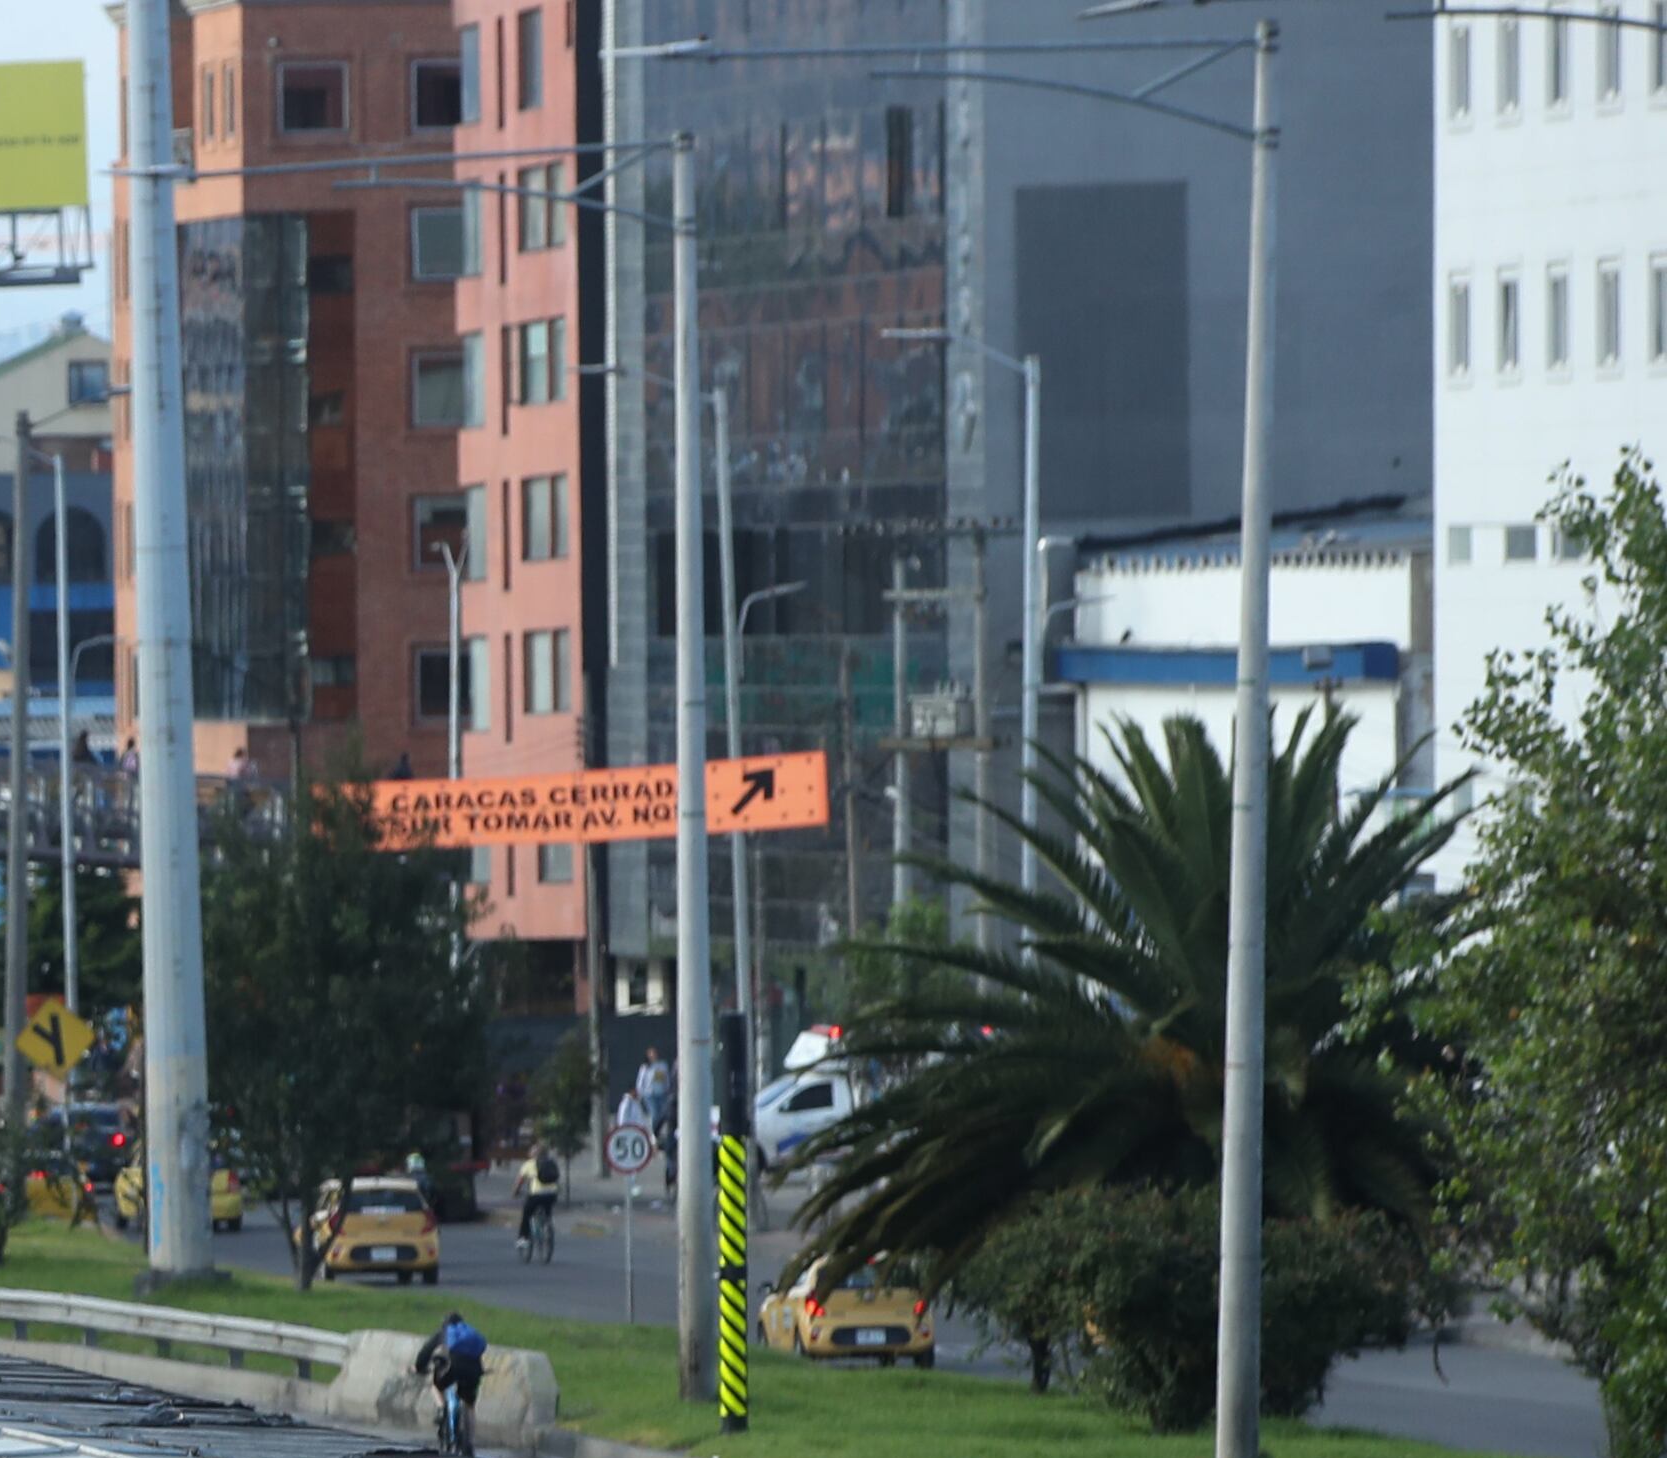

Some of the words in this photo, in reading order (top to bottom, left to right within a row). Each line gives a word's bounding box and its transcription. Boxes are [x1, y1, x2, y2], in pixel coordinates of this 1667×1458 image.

[391, 786, 536, 814] CARACAS
[549, 776, 678, 804] CERRAD
[464, 808, 573, 834] TOMAR
[616, 1135, 646, 1161] 50
